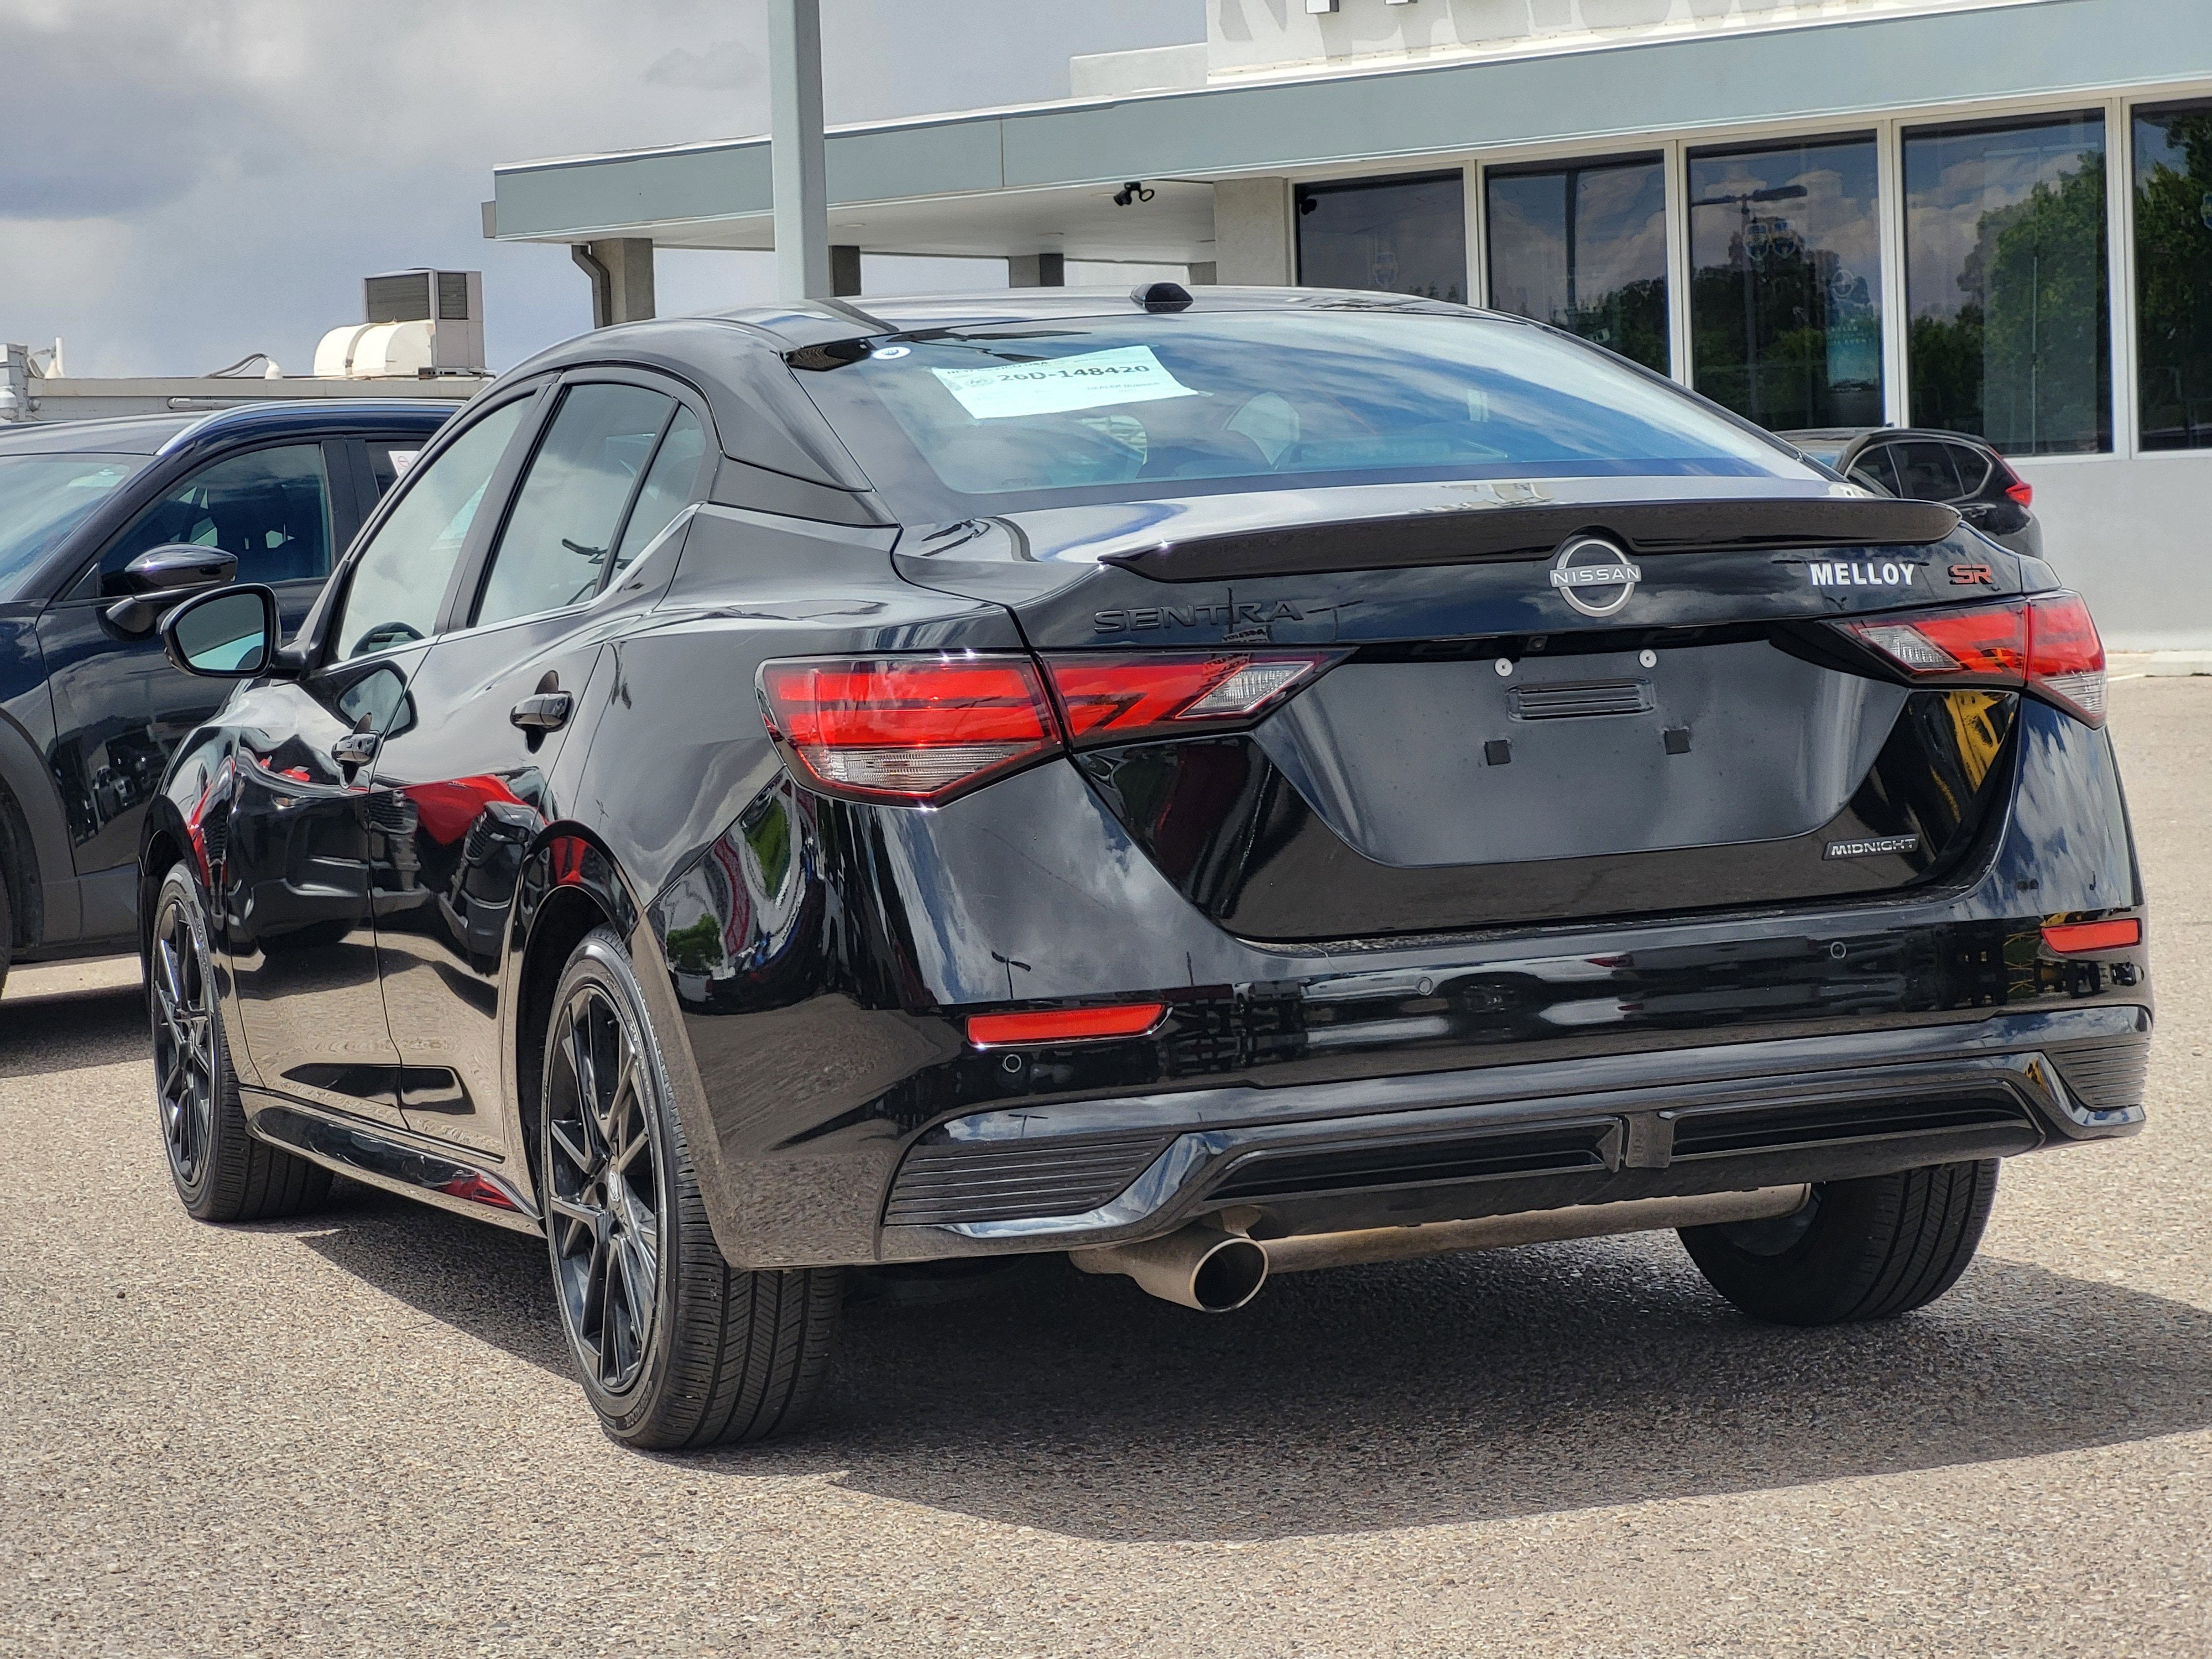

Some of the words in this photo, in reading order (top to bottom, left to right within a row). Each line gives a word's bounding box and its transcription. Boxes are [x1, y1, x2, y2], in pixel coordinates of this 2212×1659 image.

[997, 365, 1150, 381] 26D-148420
[1553, 567, 1639, 585] NISSAN
[1810, 562, 1915, 586] MELLOY
[1948, 564, 1994, 585] SR
[1094, 601, 1304, 634] SENTRA
[1831, 838, 1916, 855] MIDNIGHT
